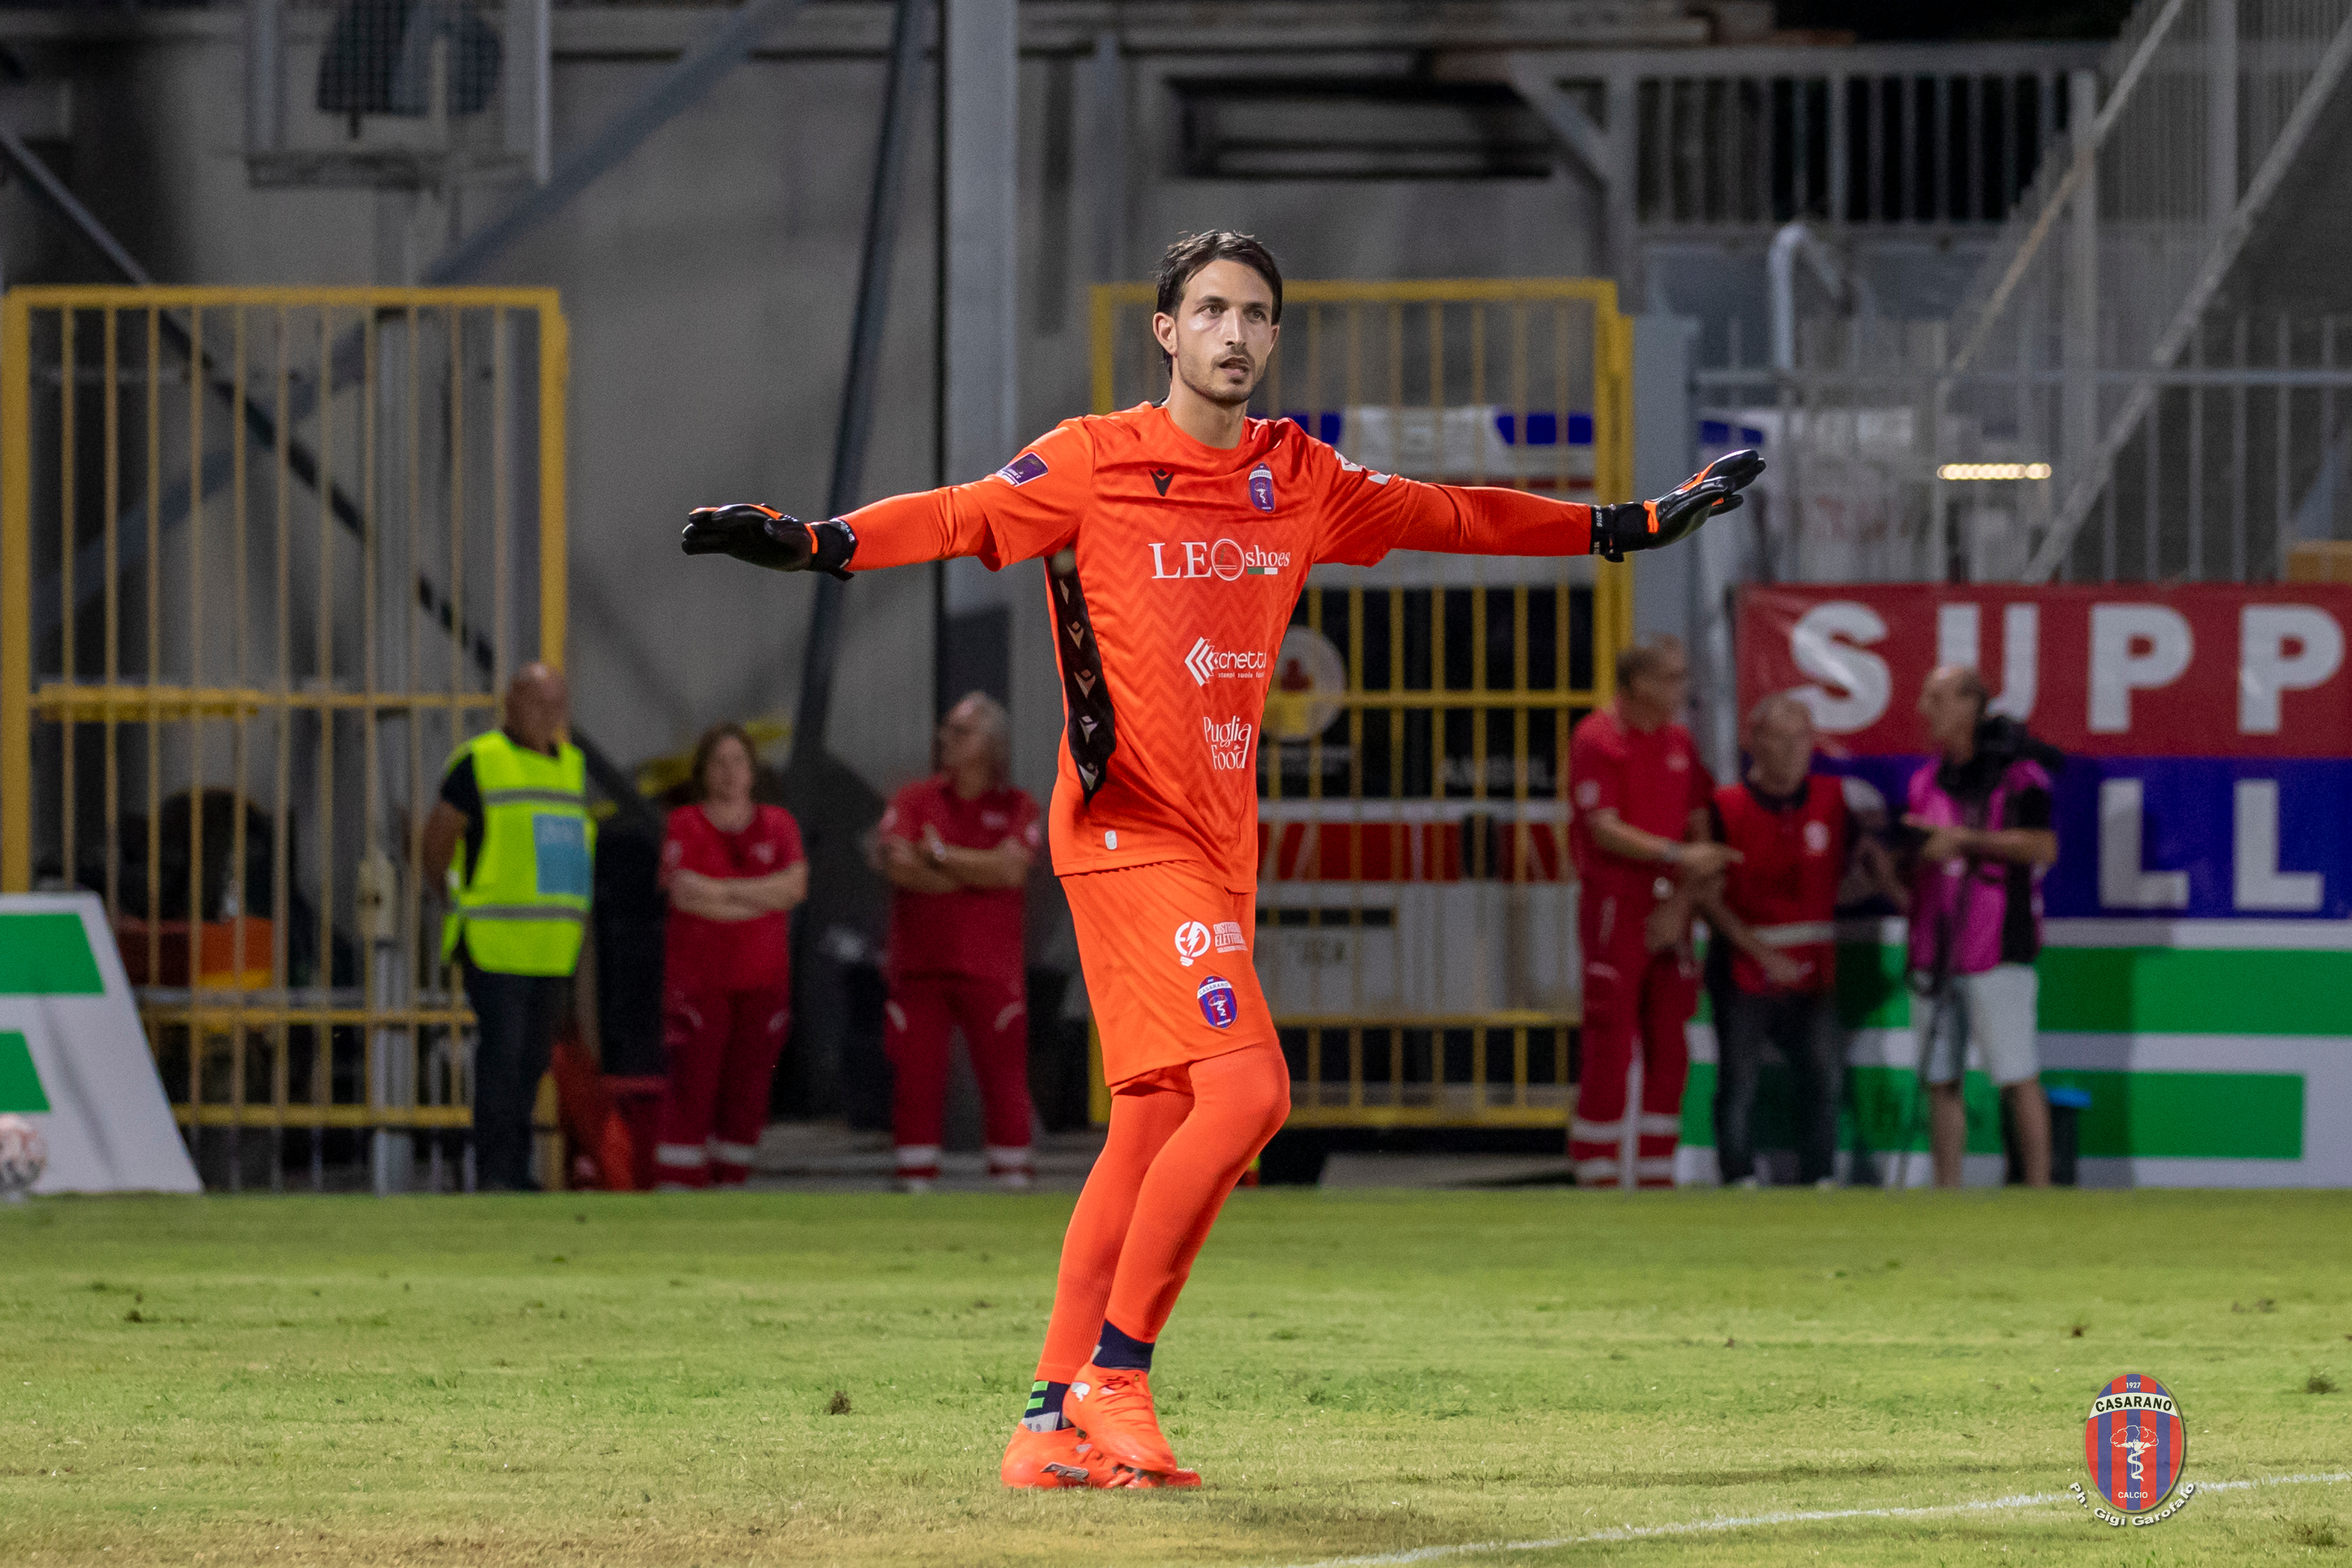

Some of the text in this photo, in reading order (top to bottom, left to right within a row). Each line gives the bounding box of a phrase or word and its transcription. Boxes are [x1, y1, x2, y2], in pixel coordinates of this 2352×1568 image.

[1245, 545, 1291, 568] shoes
[1203, 715, 1252, 748] Puglia
[1211, 744, 1246, 770] Food
